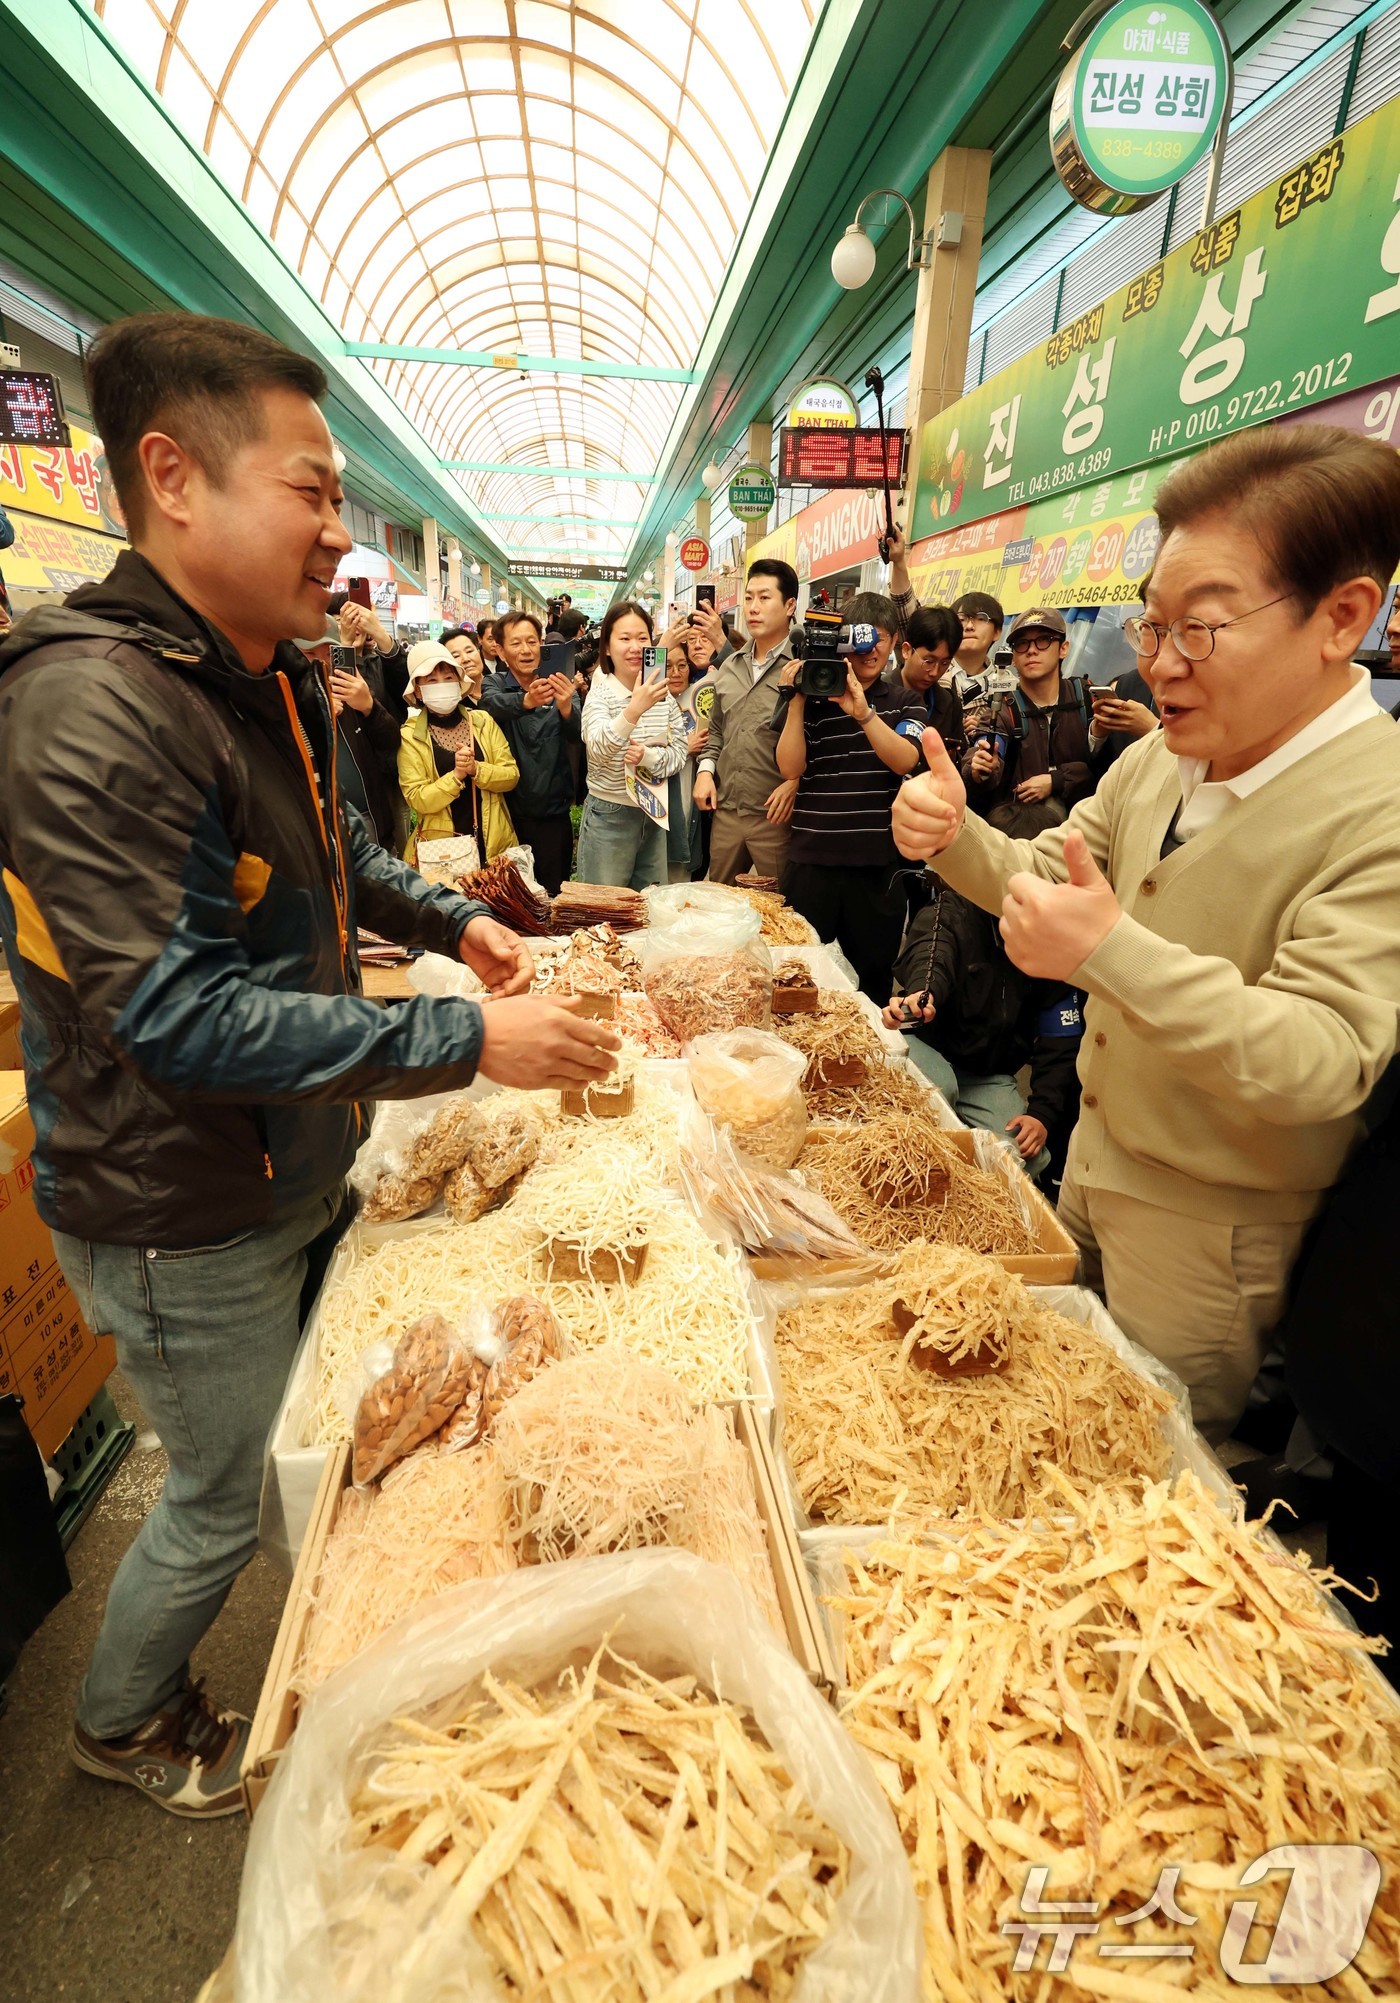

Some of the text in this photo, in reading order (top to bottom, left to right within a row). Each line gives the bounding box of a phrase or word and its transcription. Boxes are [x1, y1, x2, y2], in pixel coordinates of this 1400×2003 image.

[1090, 72, 1210, 119] 진성 상회
[1101, 138, 1182, 160] 838-4389
[1047, 141, 1344, 368] 각종야채 모종 식품 잡화
[797, 417, 849, 428] BAN THAI
[1008, 482, 1026, 503] TEL
[1029, 447, 1112, 495] 043.838.4389
[1186, 352, 1353, 440] 010.9722.2012
[812, 489, 887, 562] BANGKOK
[949, 523, 984, 553] 고구마
[684, 551, 706, 562] MART
[686, 542, 704, 552] ASIA
[1040, 545, 1067, 580] 가지
[1064, 538, 1091, 576] 호박
[1088, 532, 1124, 573] 오이
[1124, 523, 1160, 571] 상추
